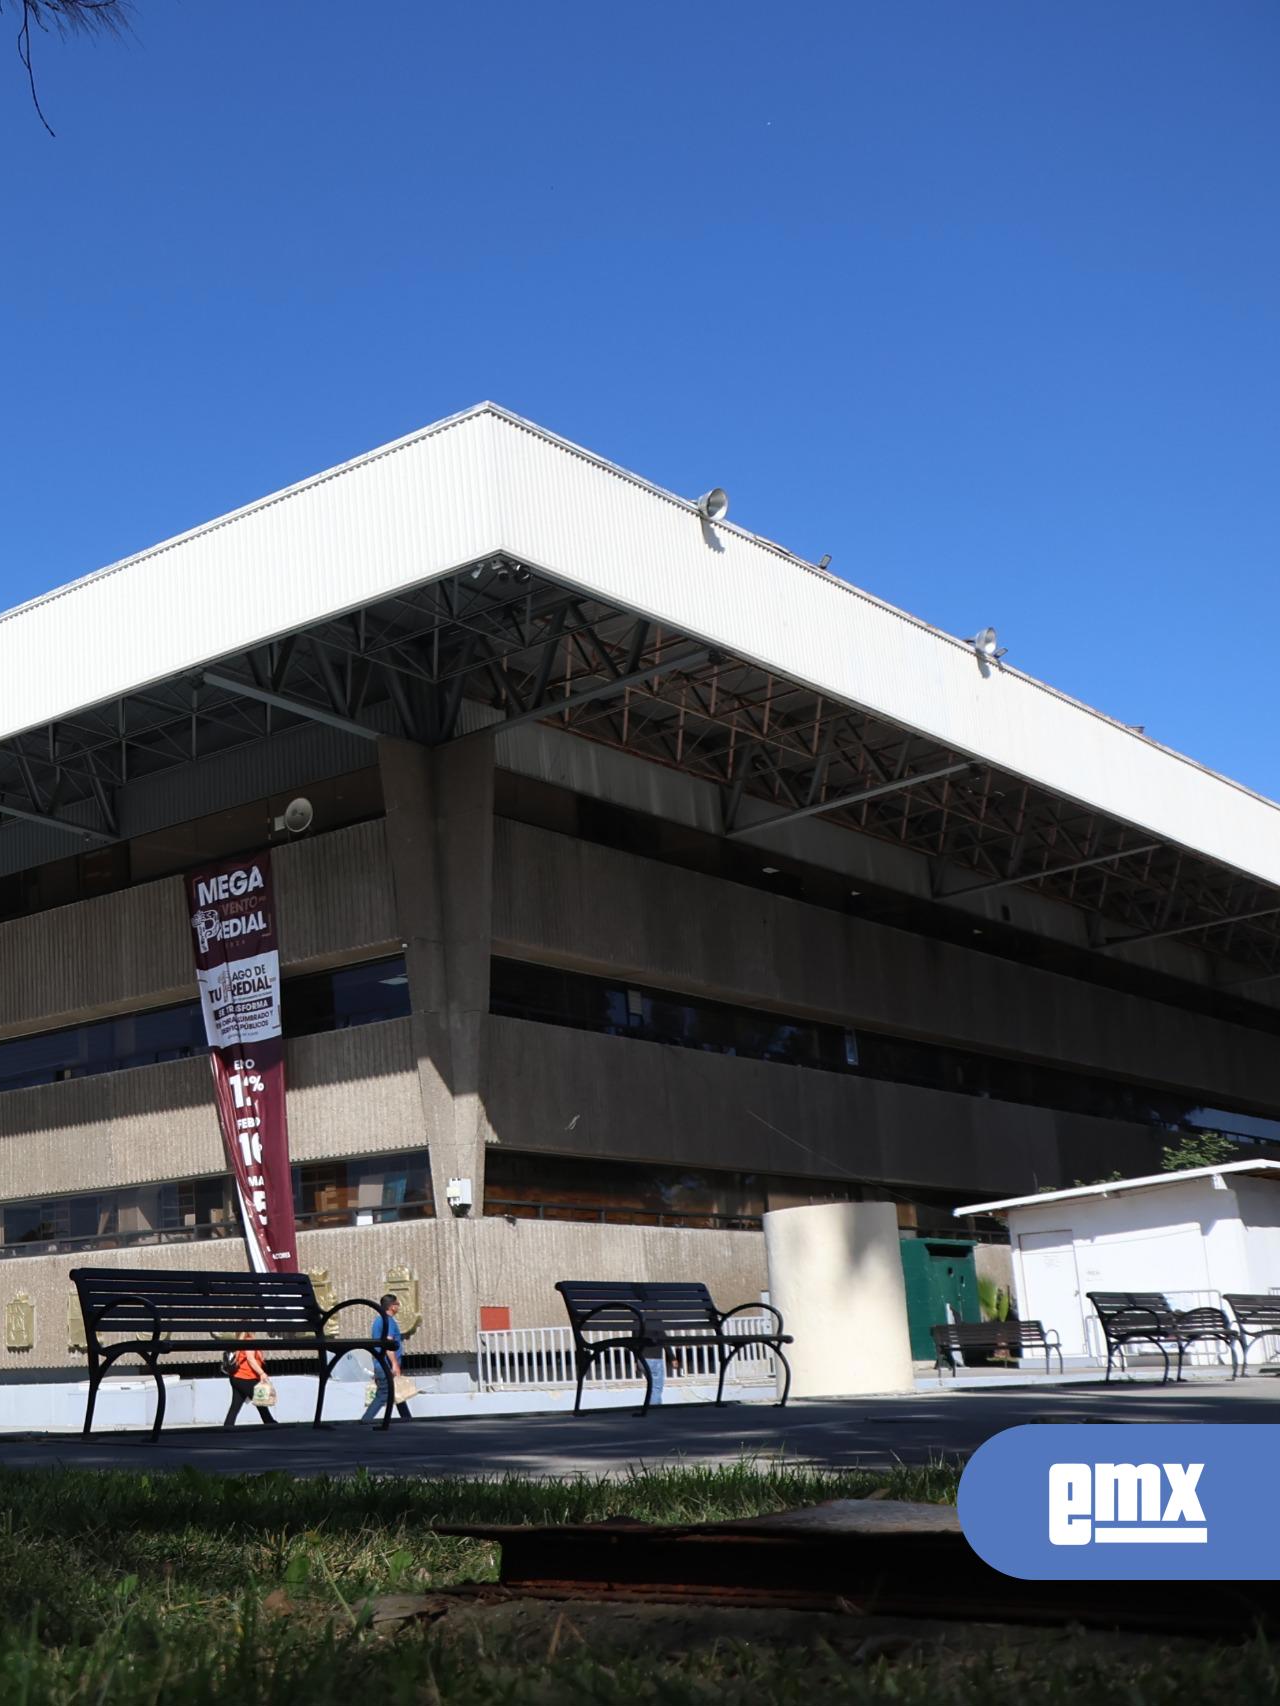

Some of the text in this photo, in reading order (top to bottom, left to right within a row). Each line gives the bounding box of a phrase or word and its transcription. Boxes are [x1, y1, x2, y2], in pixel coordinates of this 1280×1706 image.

[197, 865, 265, 906] MEGA
[254, 964, 266, 976] DE
[208, 986, 222, 1003] TU
